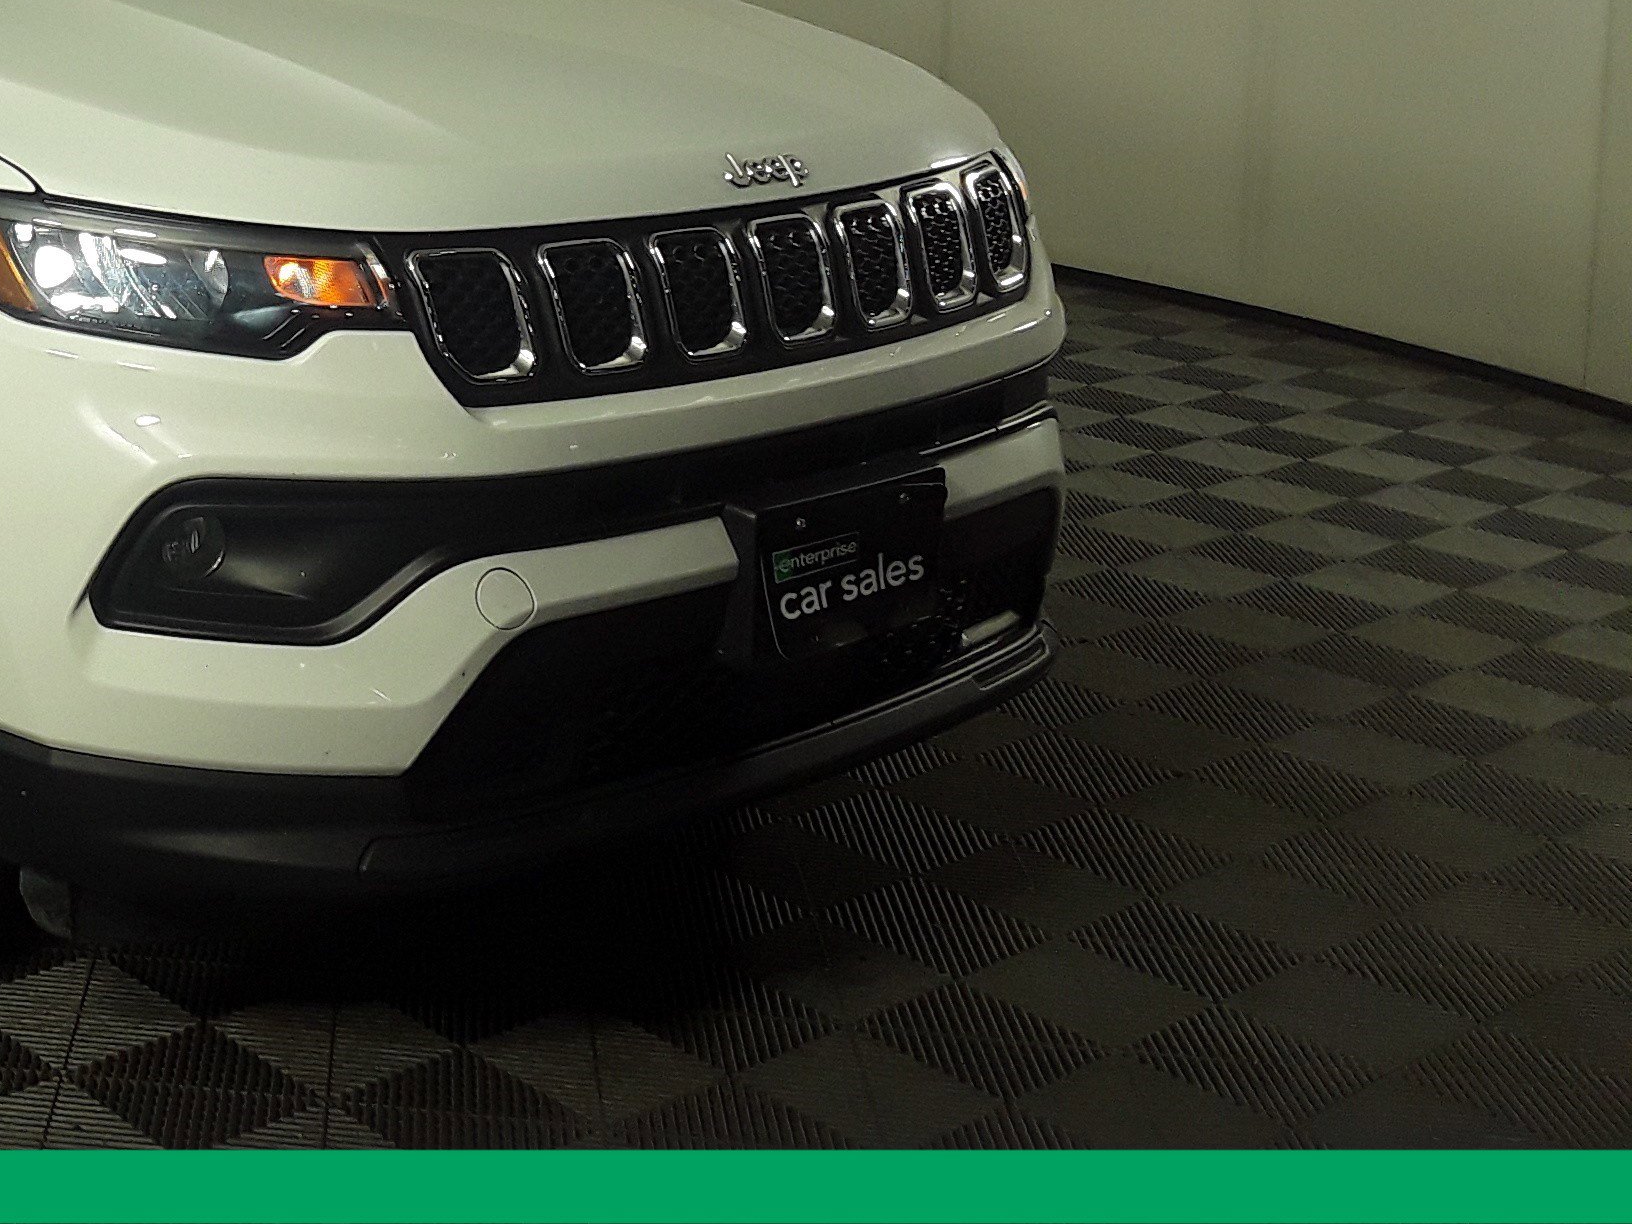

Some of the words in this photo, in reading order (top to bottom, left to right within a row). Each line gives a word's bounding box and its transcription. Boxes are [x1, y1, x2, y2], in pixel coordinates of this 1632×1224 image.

[723, 152, 809, 188] Jeep
[777, 539, 858, 573] enterprise
[779, 579, 833, 620] car
[840, 552, 925, 602] sales
